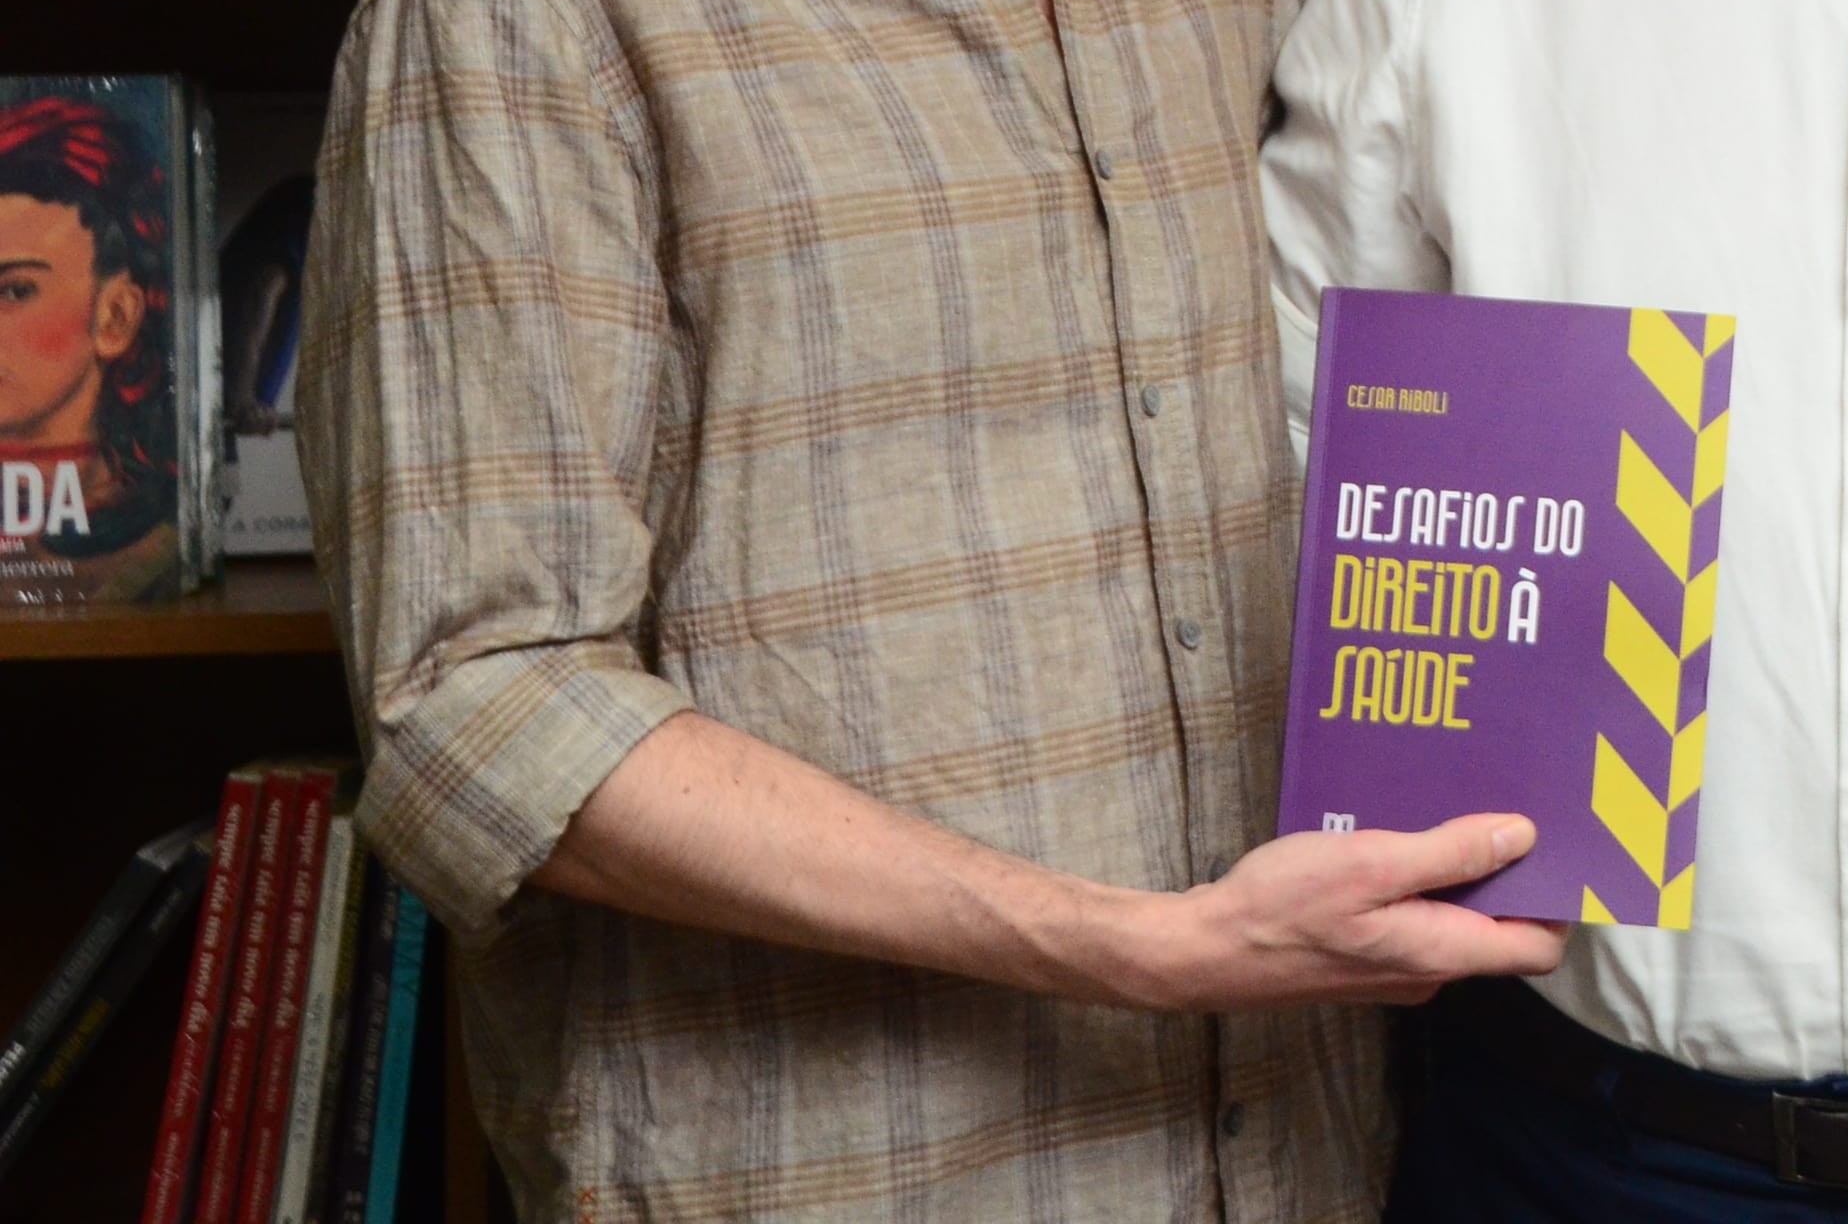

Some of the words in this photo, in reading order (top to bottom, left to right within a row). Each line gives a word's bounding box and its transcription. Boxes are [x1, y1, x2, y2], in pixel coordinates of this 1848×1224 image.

[1347, 385, 1395, 410] CESAR
[1398, 388, 1449, 414] RIBOLI
[1337, 482, 1526, 550] DESAFIOS
[1534, 498, 1585, 556] DO
[1330, 554, 1502, 641] DIREITO
[1507, 567, 1540, 645] À
[1319, 645, 1474, 730] SAÚDE
